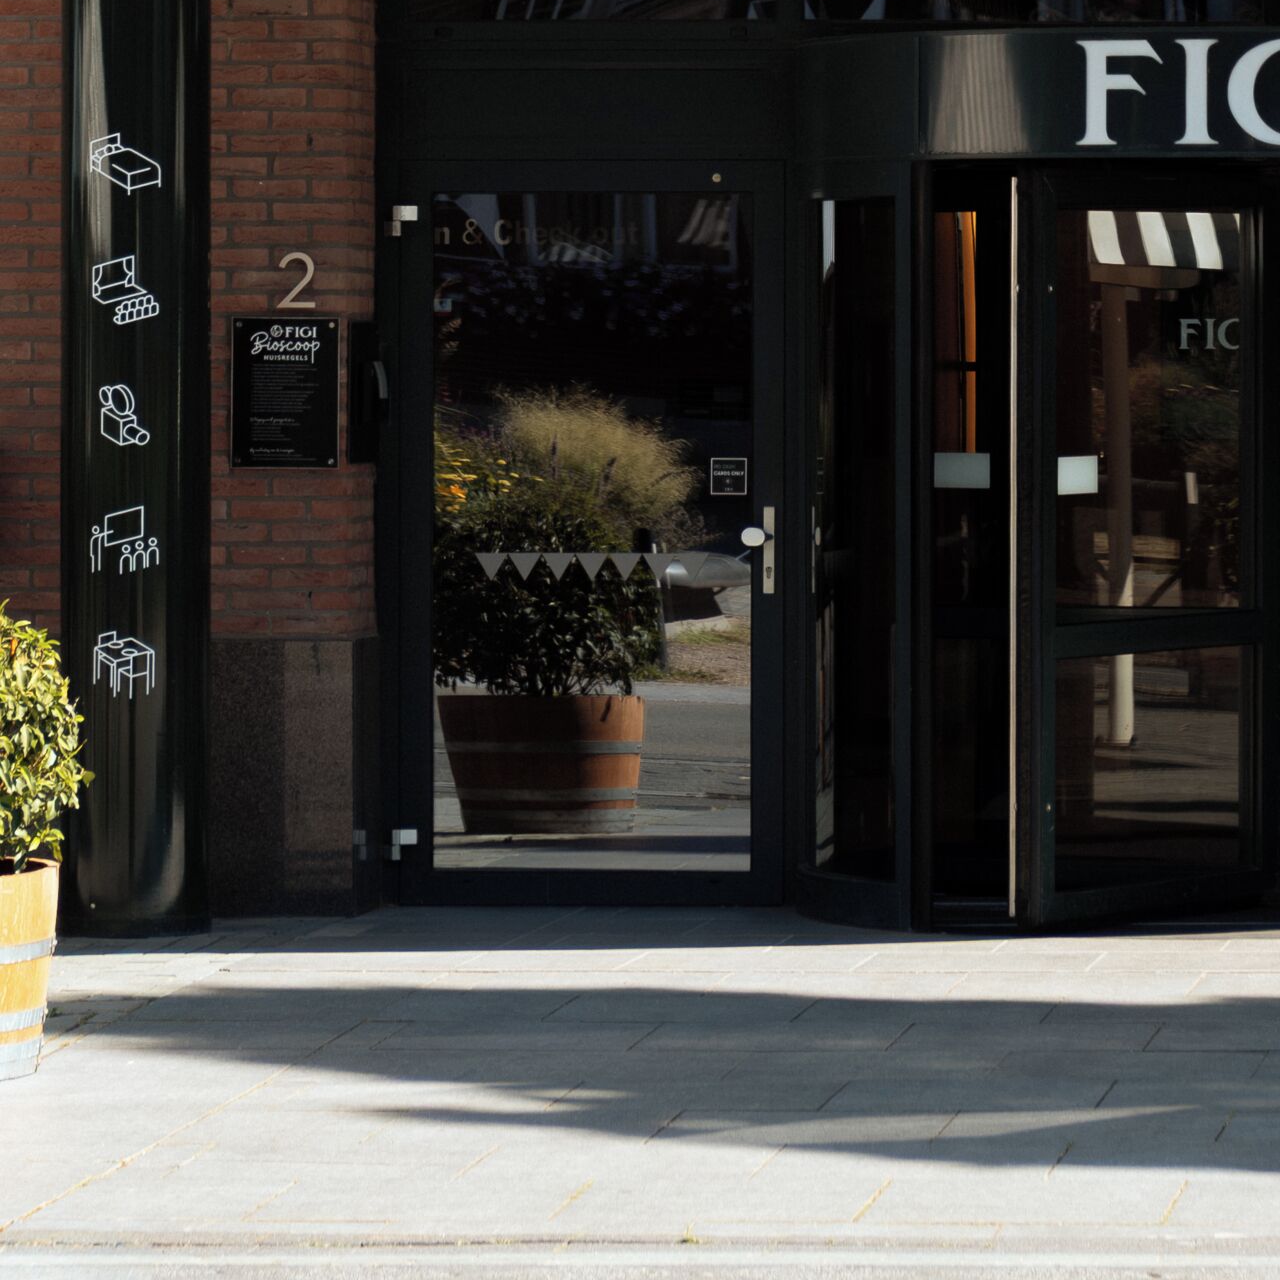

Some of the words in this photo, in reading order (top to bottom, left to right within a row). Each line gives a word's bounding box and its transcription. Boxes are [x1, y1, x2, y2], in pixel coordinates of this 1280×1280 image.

[461, 217, 484, 246] &
[493, 217, 581, 247] Check
[276, 251, 316, 309] 2
[249, 330, 321, 365] Bioscoop
[285, 326, 318, 339] FIGI
[263, 354, 309, 362] HUISREGELS
